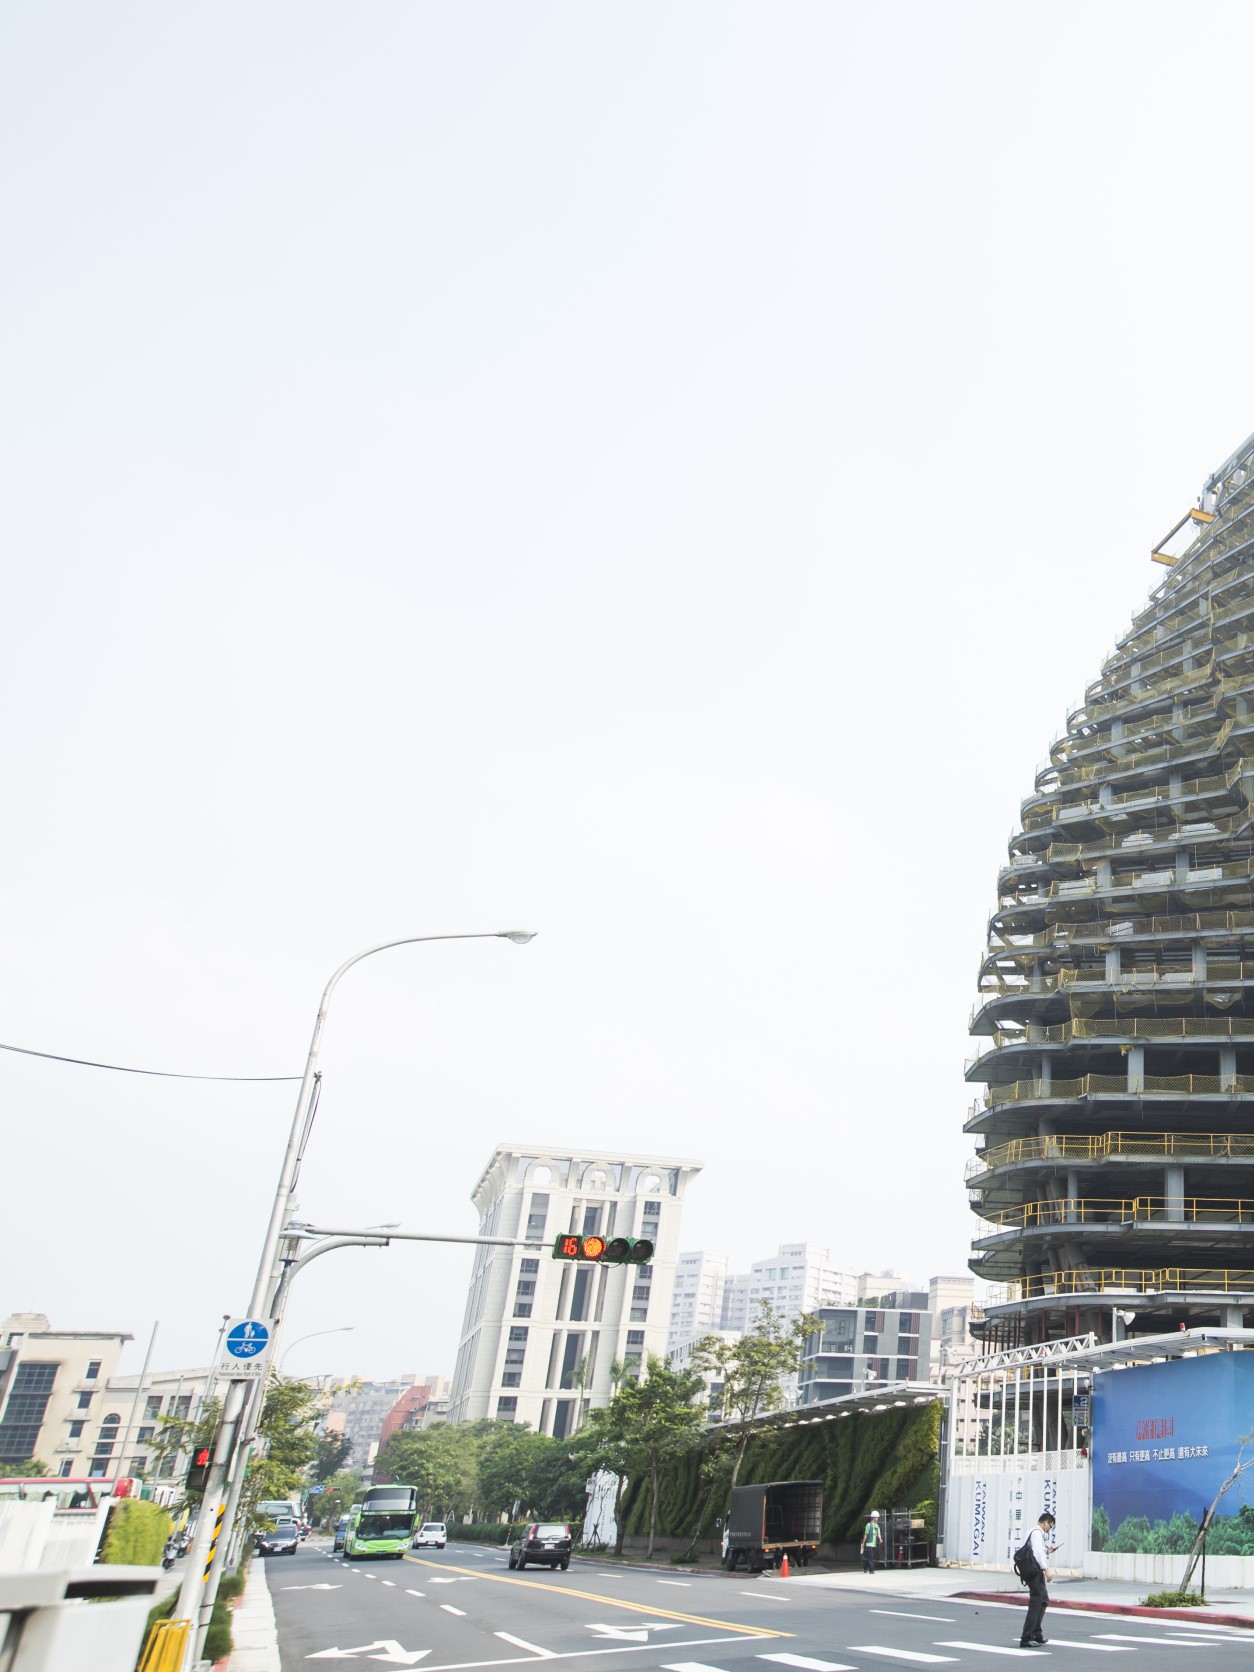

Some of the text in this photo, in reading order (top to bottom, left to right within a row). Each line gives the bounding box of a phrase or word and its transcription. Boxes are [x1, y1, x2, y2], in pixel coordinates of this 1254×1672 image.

[221, 1362, 263, 1370] 行人優先
[973, 1481, 981, 1556] KUMAGAI
